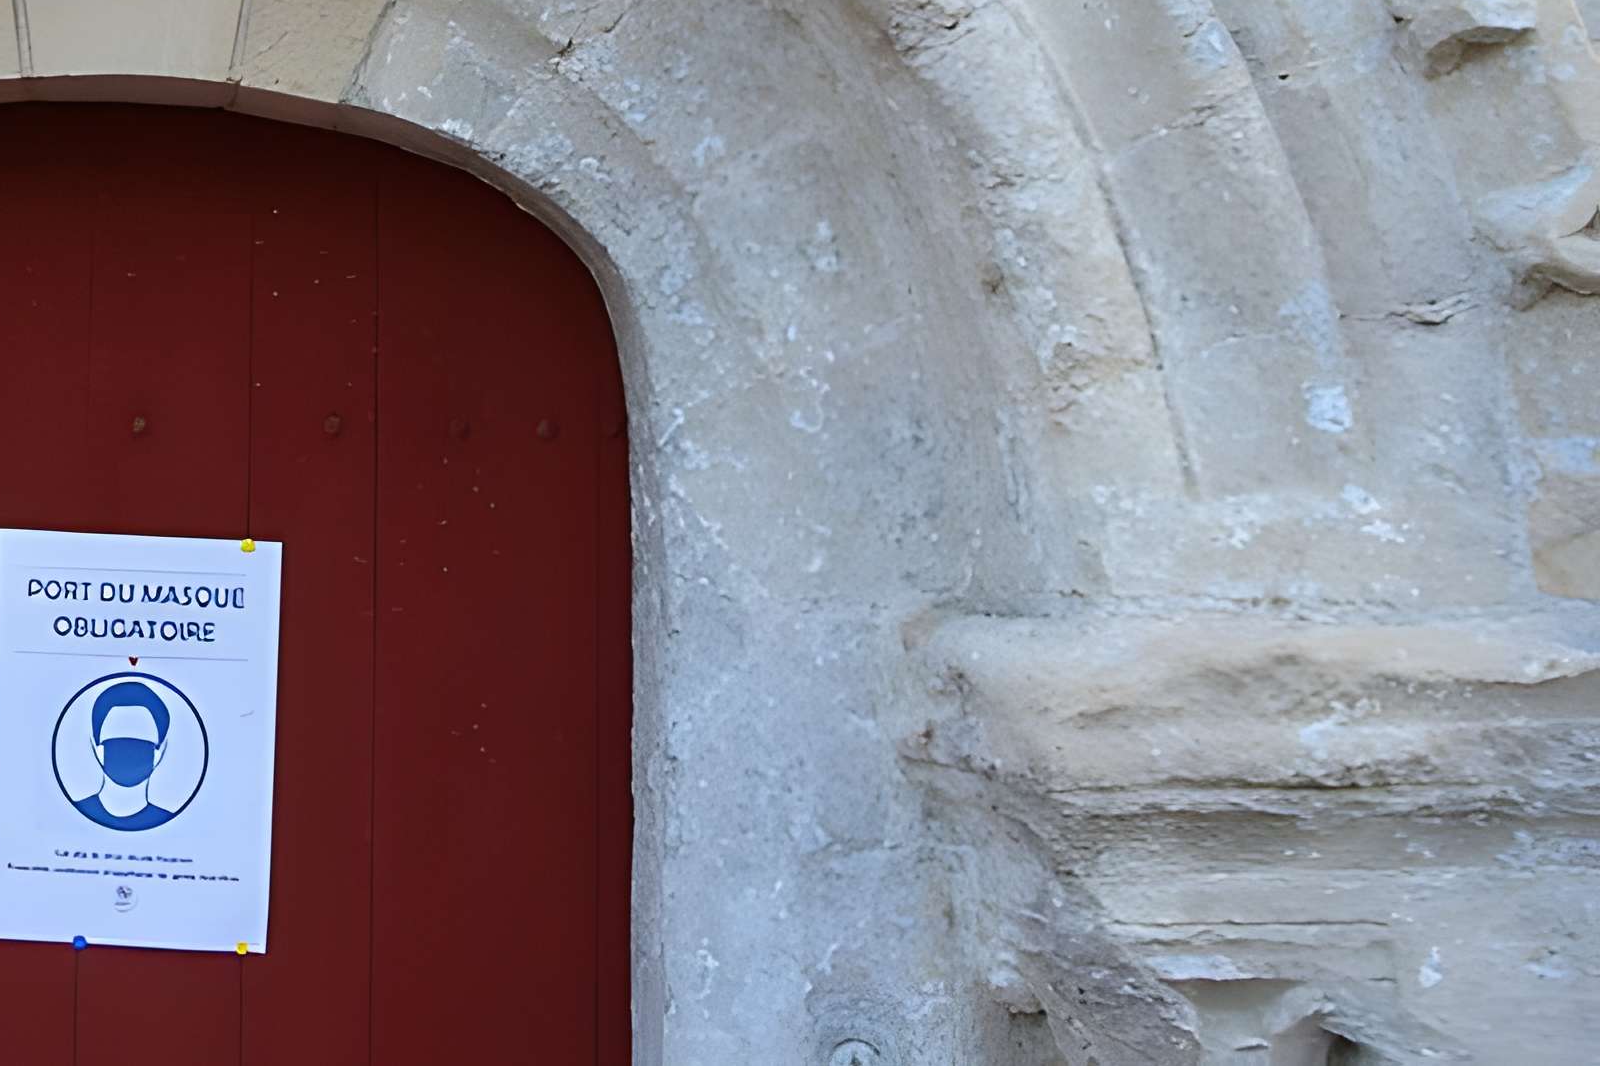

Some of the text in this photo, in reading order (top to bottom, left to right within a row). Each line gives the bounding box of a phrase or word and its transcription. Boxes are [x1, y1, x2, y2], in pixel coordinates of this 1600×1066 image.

[27, 578, 245, 609] PORT DU MASQUE
